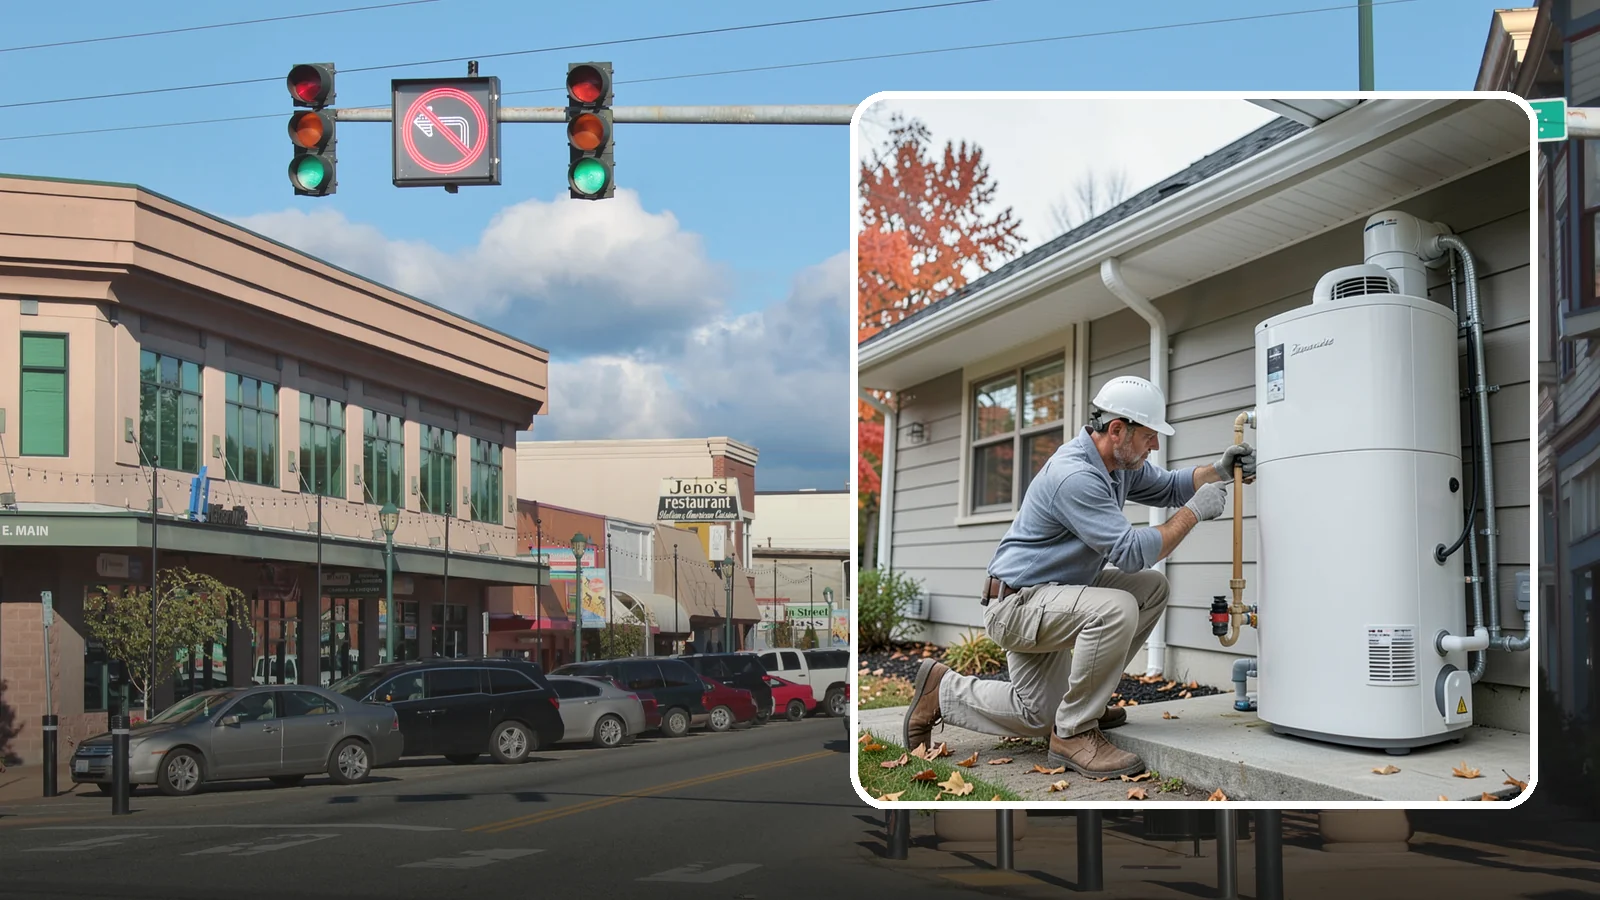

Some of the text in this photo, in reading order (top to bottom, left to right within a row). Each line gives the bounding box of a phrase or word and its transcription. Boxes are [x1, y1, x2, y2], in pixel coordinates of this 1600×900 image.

[669, 480, 727, 495] Jeno's
[665, 496, 731, 509] restaurant
[658, 509, 681, 519] Italian
[686, 509, 714, 519] American
[715, 509, 737, 519] Cuisine
[2, 525, 49, 536] E. MAIN
[797, 607, 828, 617] Street
